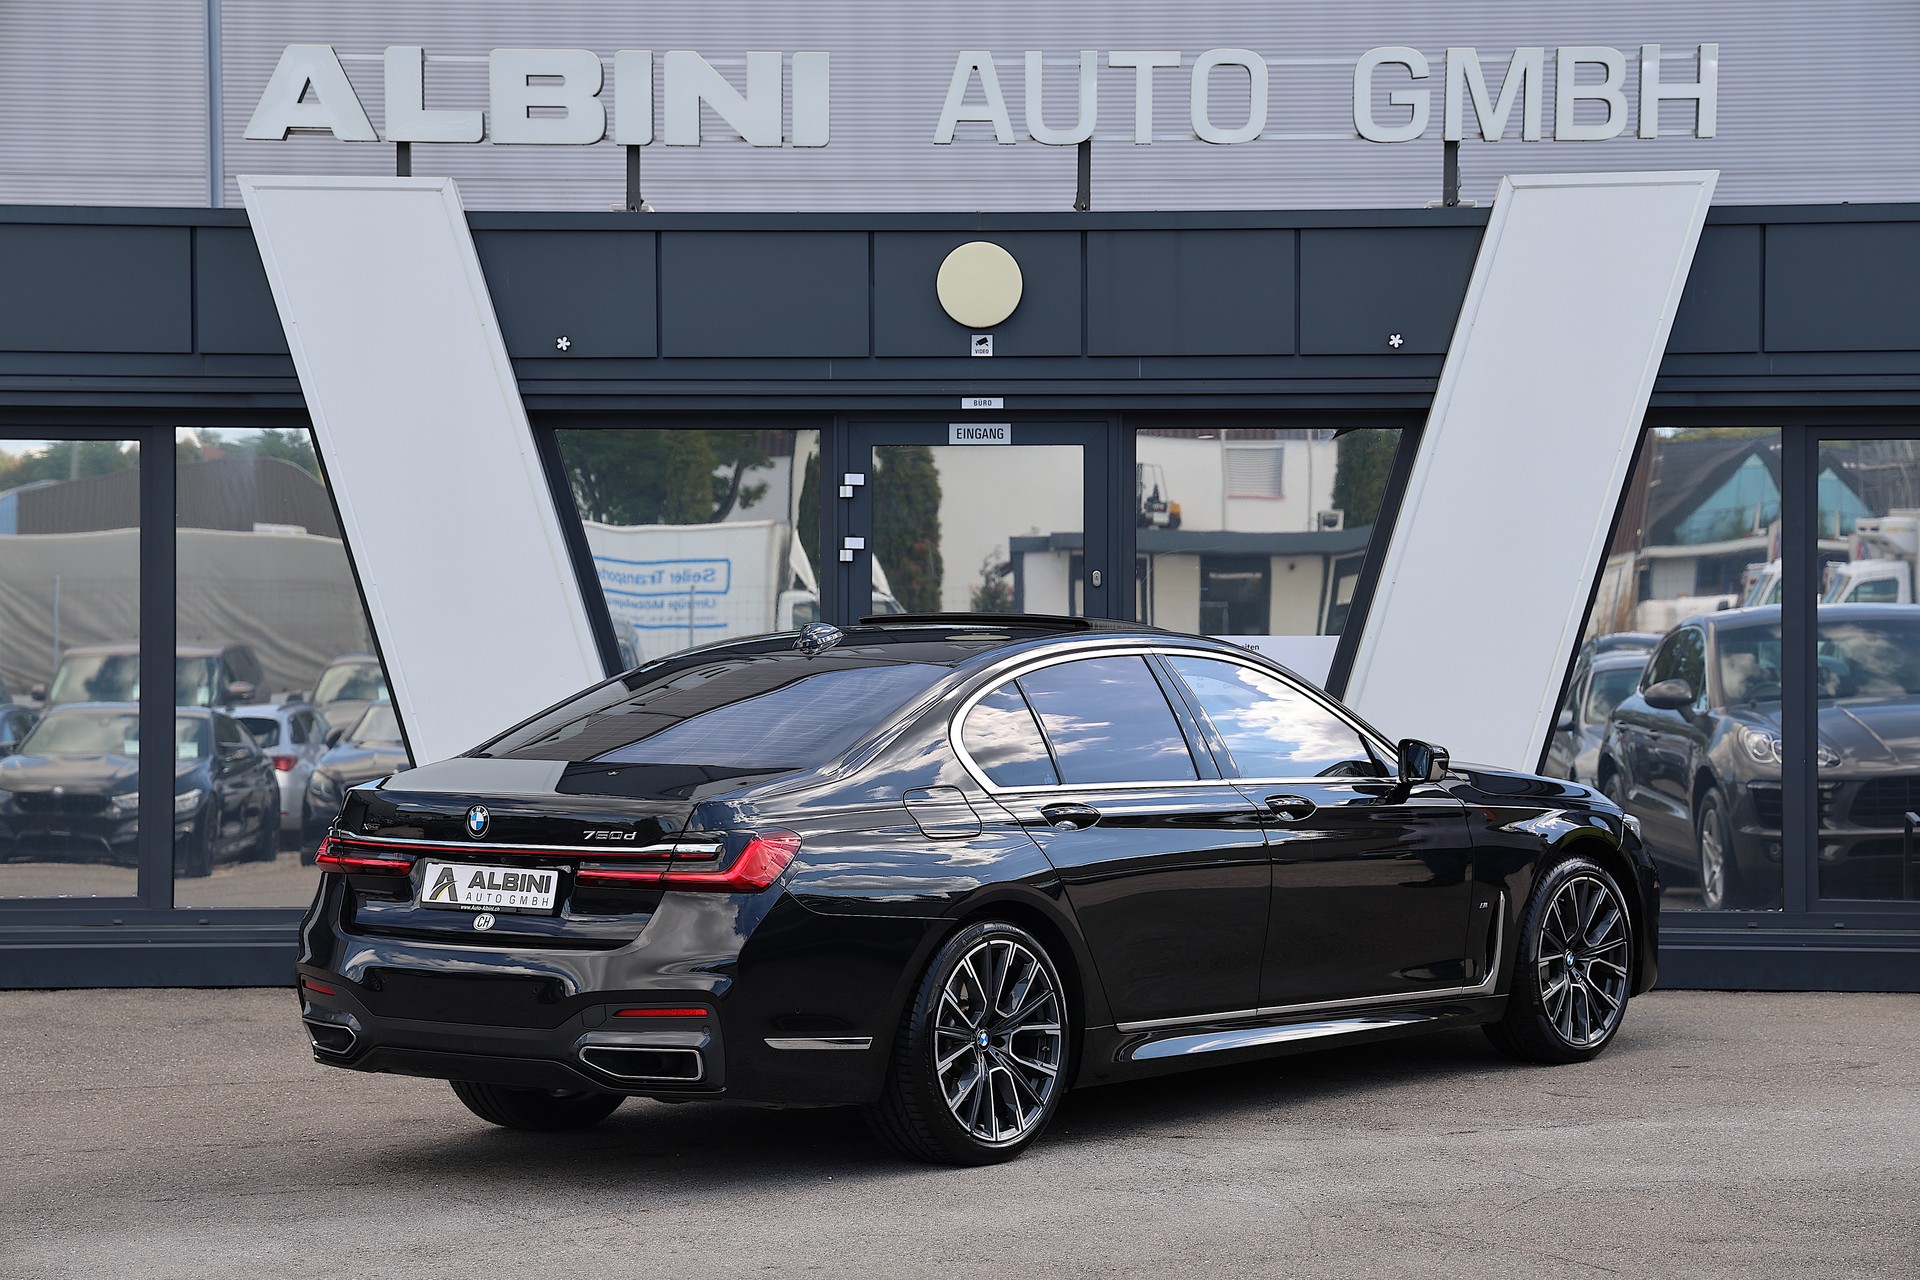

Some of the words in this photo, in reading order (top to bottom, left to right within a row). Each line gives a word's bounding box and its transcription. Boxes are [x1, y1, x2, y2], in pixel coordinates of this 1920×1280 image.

[243, 44, 830, 147] ALBINI
[933, 48, 1269, 146] AUTO
[1353, 43, 1719, 142] GMBH
[973, 398, 992, 406] BÜRO
[956, 428, 1004, 439] EINGANG
[583, 830, 637, 840] 750d
[467, 871, 552, 893] ALBINI
[466, 892, 502, 903] AUTO
[509, 894, 549, 907] GMBH
[477, 916, 491, 928] CH
